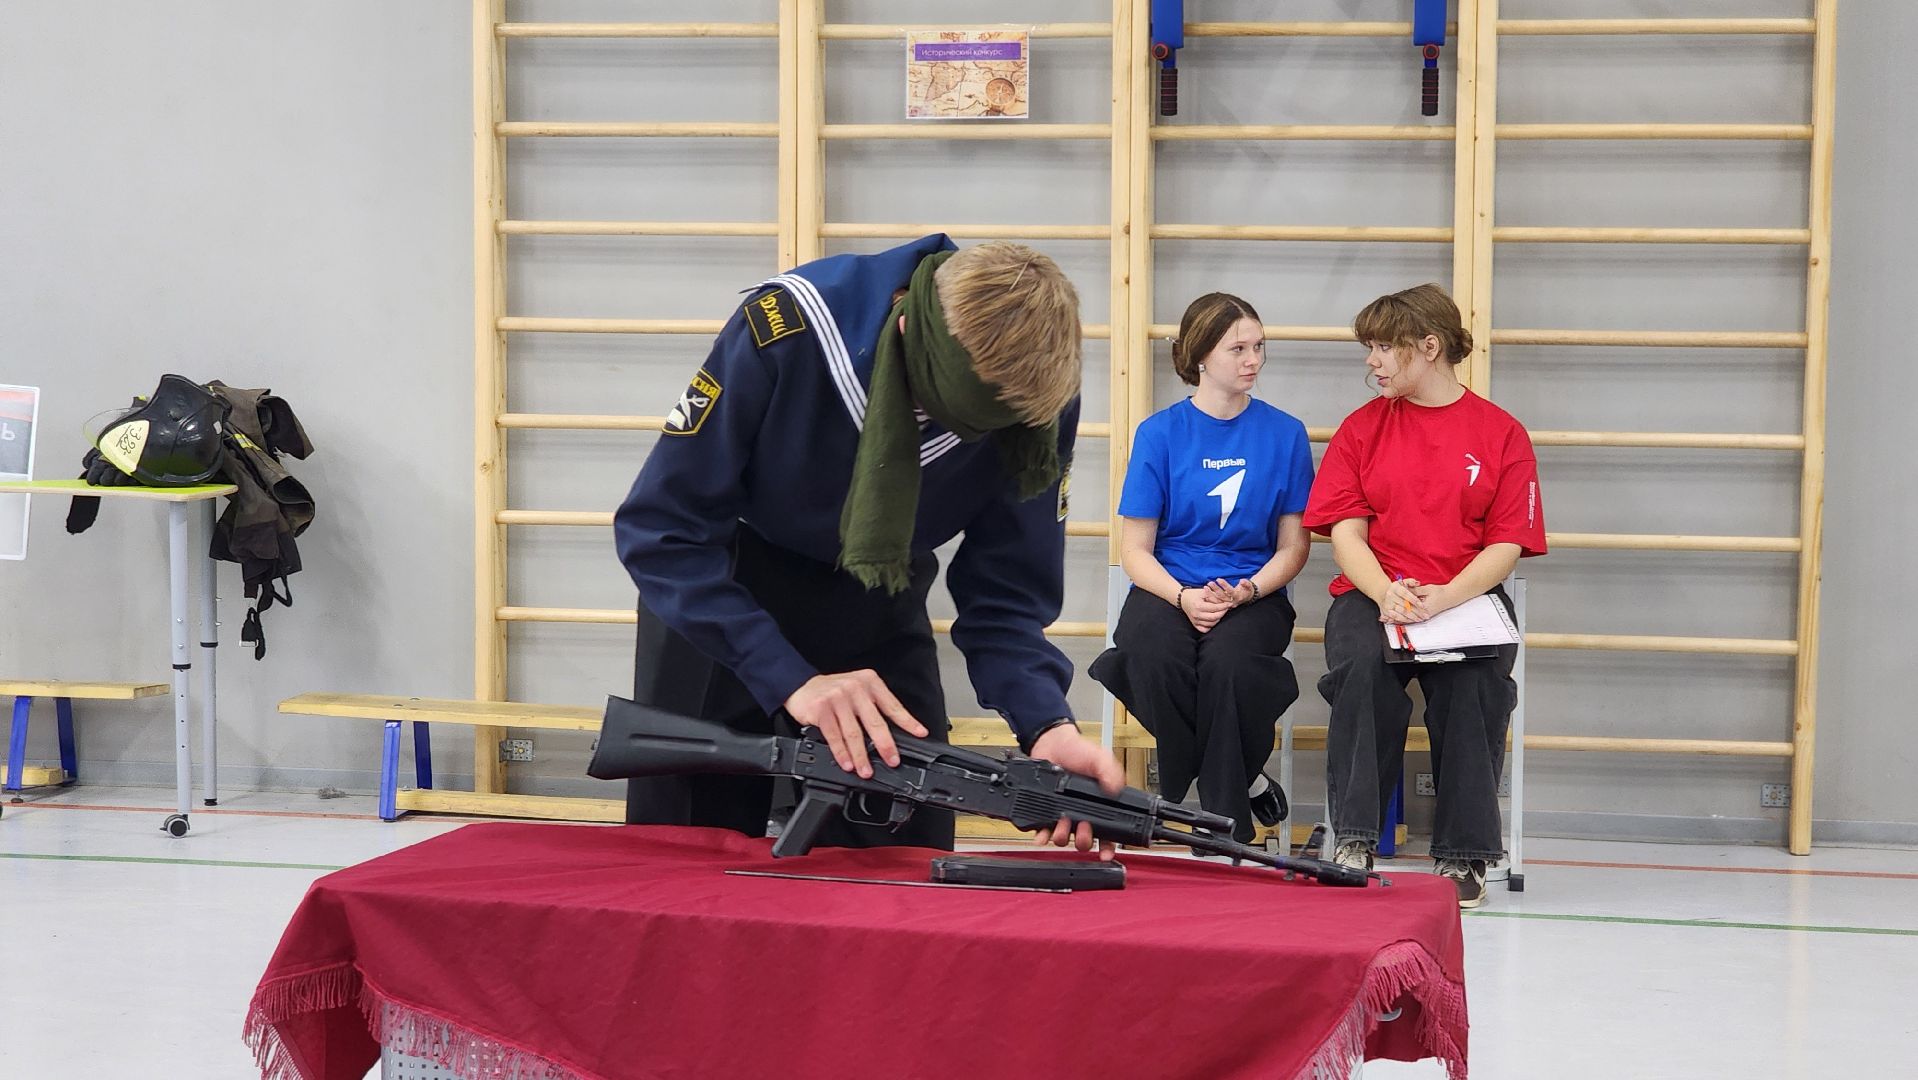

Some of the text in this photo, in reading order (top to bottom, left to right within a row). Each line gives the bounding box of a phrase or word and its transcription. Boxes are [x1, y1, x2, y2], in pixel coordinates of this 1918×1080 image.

[921, 47, 1003, 59] Исторический конкурс
[1203, 458, 1246, 470] Первые
